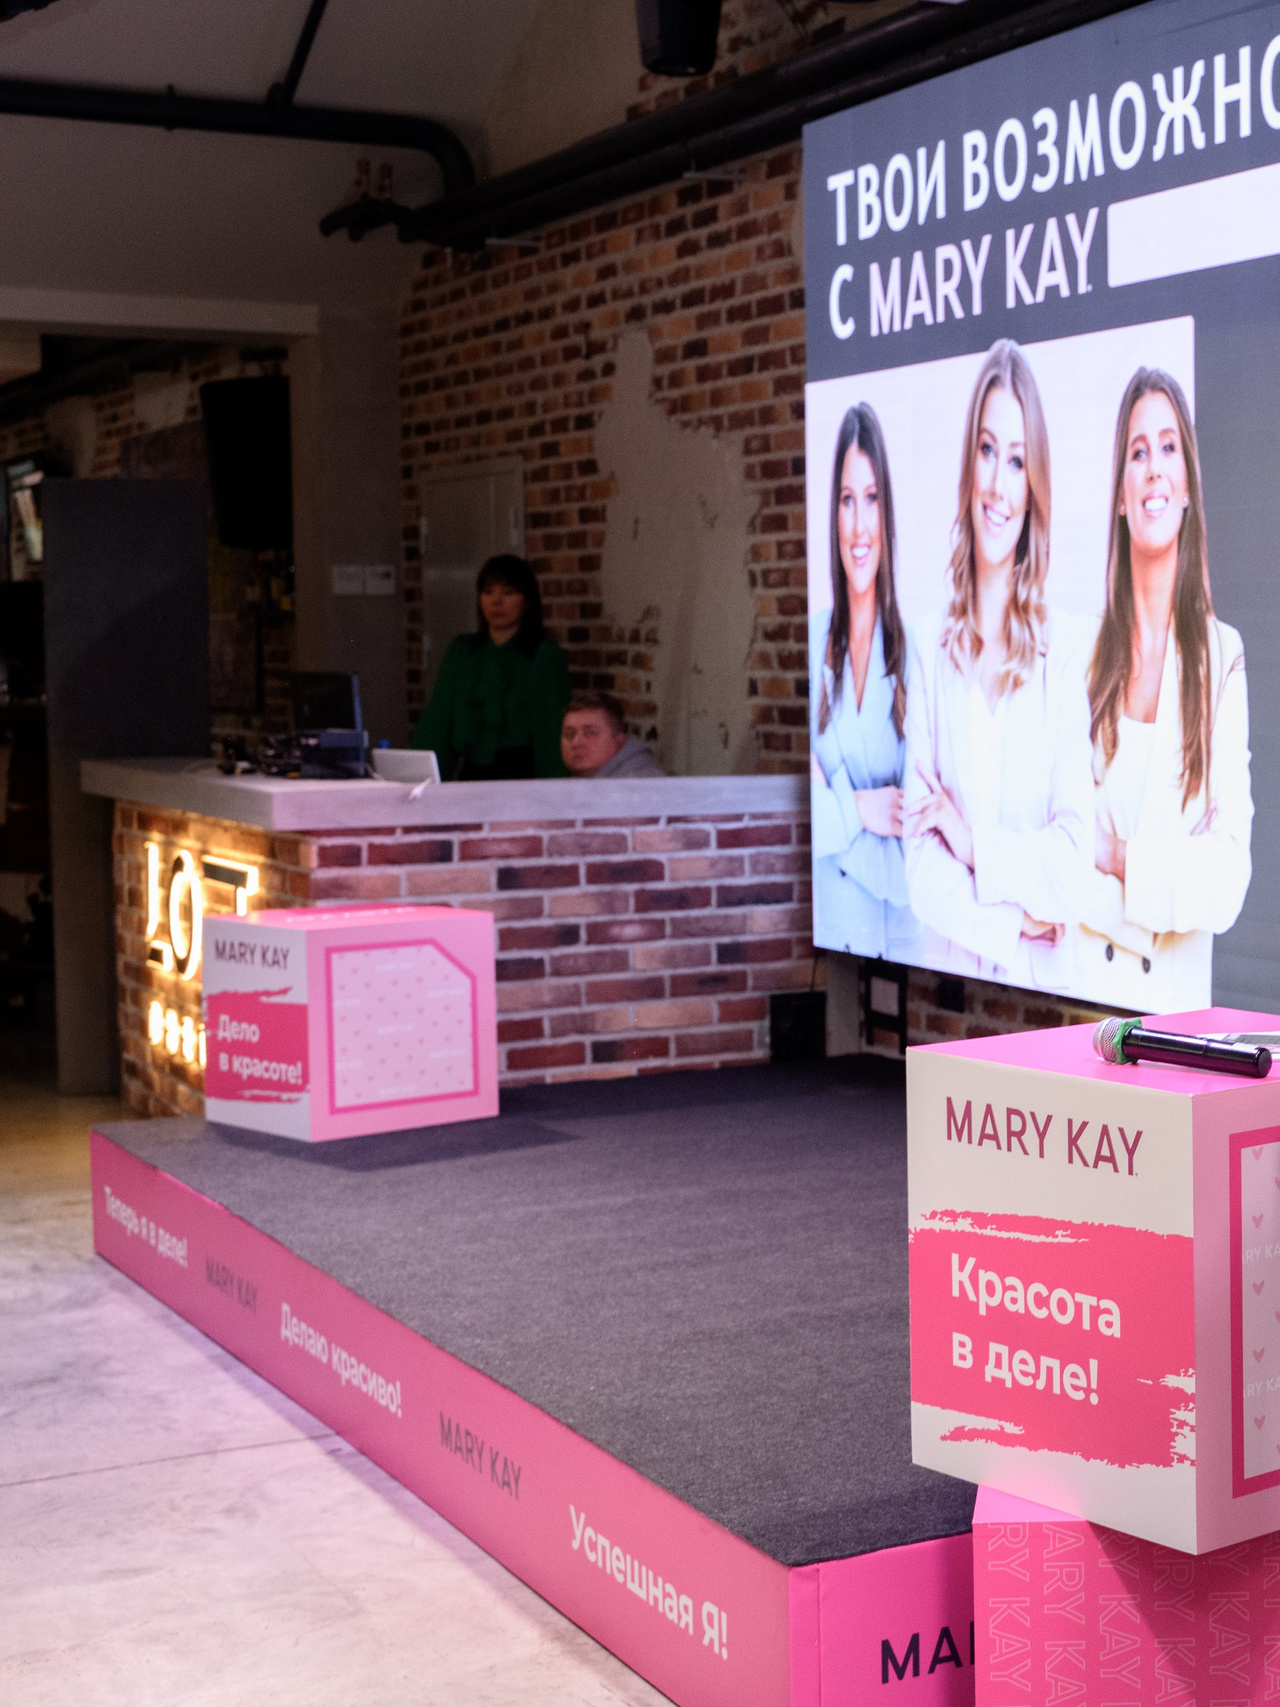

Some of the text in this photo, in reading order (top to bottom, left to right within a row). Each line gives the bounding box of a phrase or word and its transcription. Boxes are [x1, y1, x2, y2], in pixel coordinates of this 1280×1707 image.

[827, 139, 947, 246] ТВОИ
[829, 263, 856, 340] С
[869, 232, 993, 337] MARY
[213, 938, 290, 971] MARY KAY
[217, 1013, 260, 1044] Дело
[219, 1052, 303, 1086] в красоте!
[945, 1096, 1143, 1177] MARY KAY
[104, 1184, 139, 1237] Теперь
[156, 1226, 188, 1270] деле!
[205, 1255, 257, 1314] MARY KAY
[950, 1252, 1122, 1338] Красота
[280, 1301, 403, 1419] Делаю красиво!
[951, 1331, 1099, 1405] в деле!
[439, 1410, 522, 1500] MARY KAY
[569, 1503, 728, 1661] Успешная Я!
[881, 1619, 975, 1685] MA
[989, 1597, 1032, 1693] KAY
[1100, 1594, 1141, 1690] KAY
[1153, 1545, 1196, 1707] RY KA
[1208, 1591, 1250, 1687] KAY
[1045, 1640, 1087, 1707] KA
